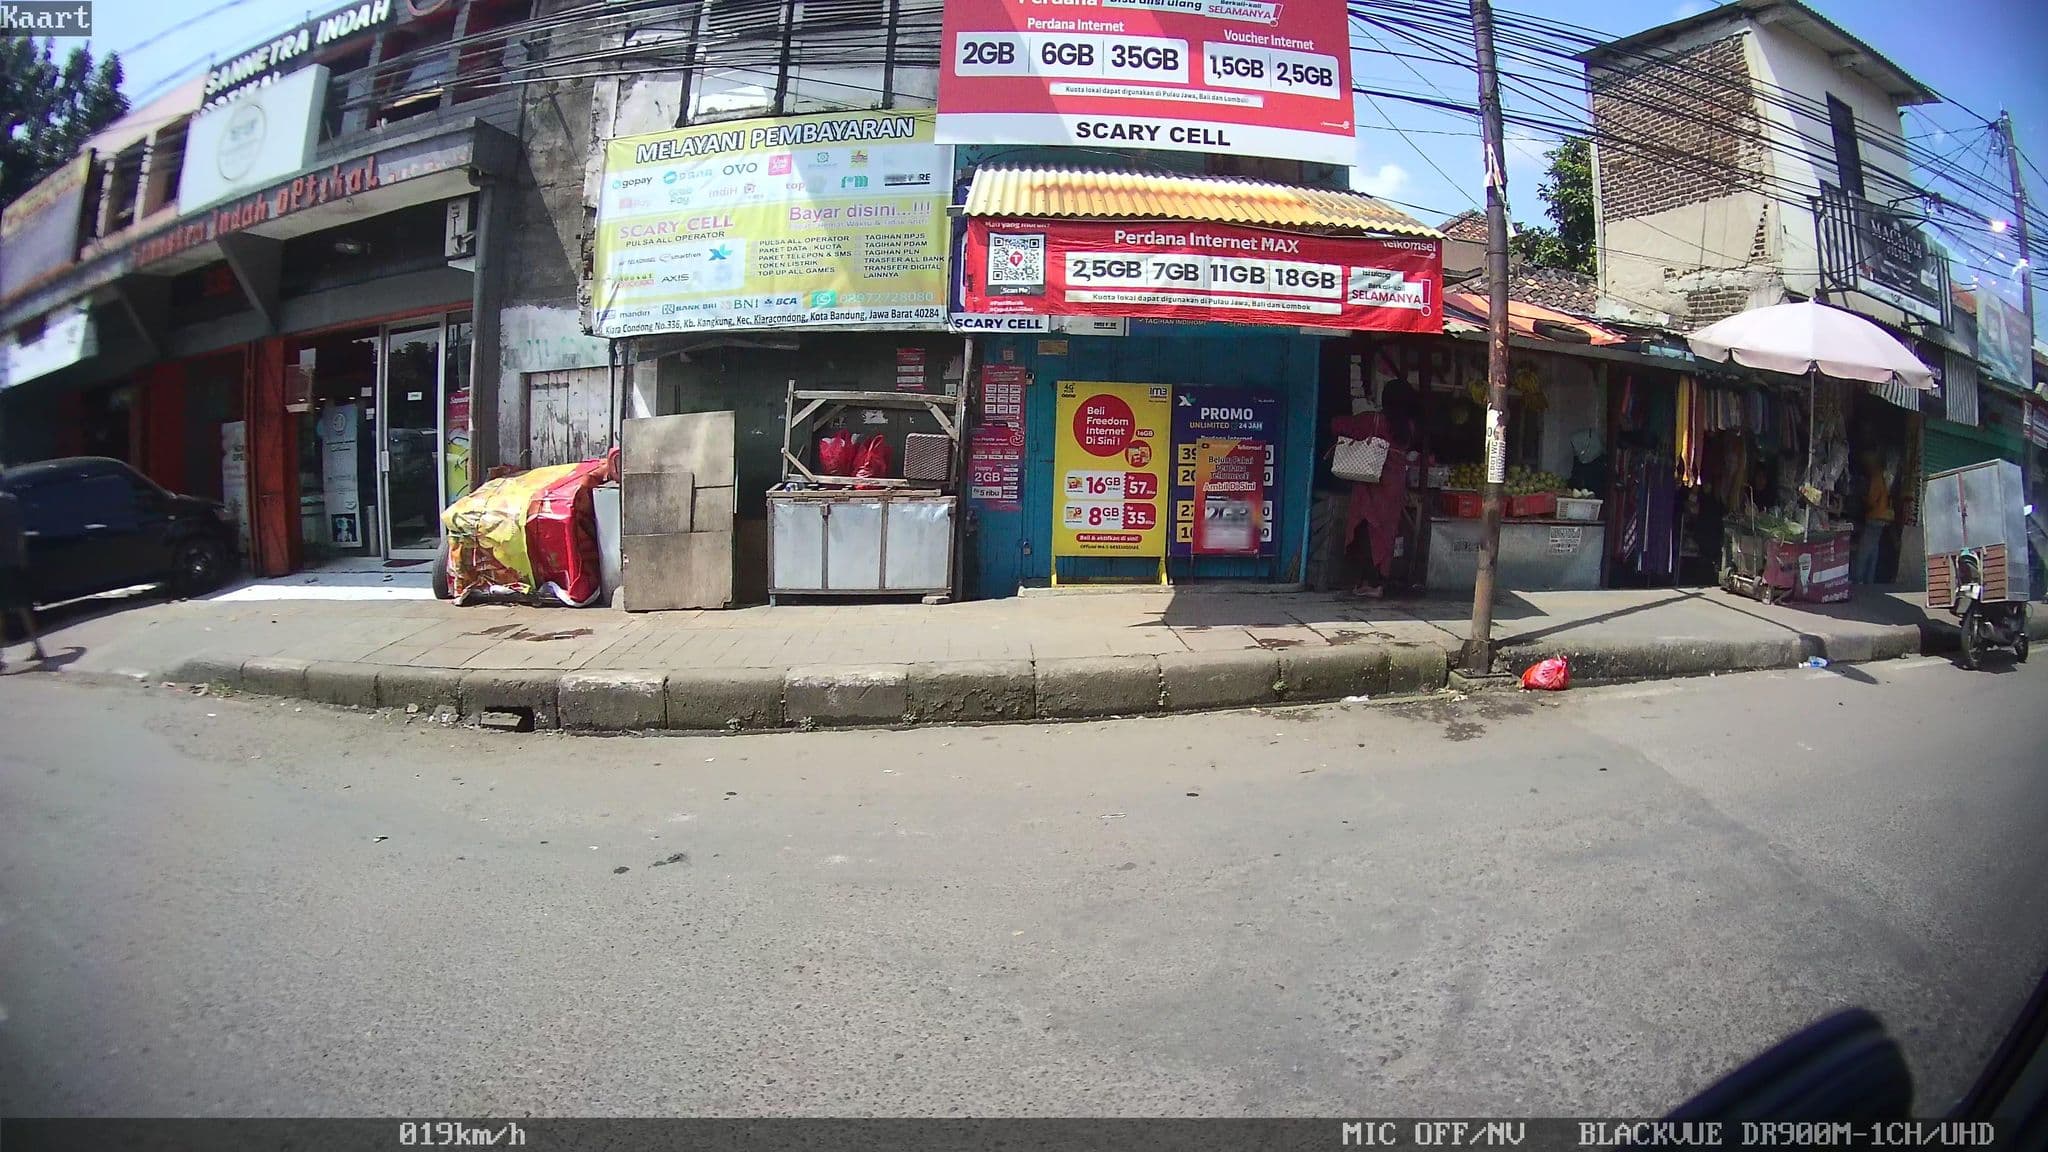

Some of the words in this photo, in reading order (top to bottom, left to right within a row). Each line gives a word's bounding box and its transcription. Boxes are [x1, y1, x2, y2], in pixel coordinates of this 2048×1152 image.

[316, 0, 390, 45] INDAH
[1027, 17, 1075, 31] Perdana
[1077, 18, 1125, 32] Internet
[1224, 29, 1269, 46] Voucher
[1271, 34, 1314, 51] Internet
[962, 42, 1015, 65] 2GB
[1042, 42, 1094, 66] 6GB
[1111, 44, 1179, 70] 35GB
[1209, 54, 1265, 79] 1,5GB
[1277, 62, 1334, 87] 2,5GB
[1102, 87, 1121, 97] dapat
[1122, 88, 1154, 97] digunakan
[1163, 90, 1180, 98] Pulau
[636, 131, 745, 164] MELAYANI
[751, 116, 915, 149] PEMBAYARAN
[1076, 121, 1160, 141] SCARY
[1170, 126, 1231, 146] CELL
[622, 176, 652, 189] gopay
[722, 162, 758, 176] OVO
[790, 205, 841, 222] Bayar
[620, 221, 679, 239] SCARY
[687, 214, 733, 230] CELL
[626, 238, 654, 247] PULSA
[656, 236, 673, 244] ALL
[675, 231, 725, 242] OPERATOR
[804, 235, 850, 243] OPERATOR
[1114, 230, 1186, 246] Perdana
[1190, 231, 1257, 250] Internet
[1261, 237, 1299, 253] MAX
[662, 273, 689, 283] AXIS
[1072, 260, 1141, 281] 2,5GB
[1153, 262, 1199, 281] 7GB
[1210, 264, 1265, 284] 11GB
[1275, 268, 1335, 289] 18GB
[676, 304, 700, 312] BANK
[734, 299, 758, 310] BNI
[776, 297, 797, 305] BCA
[1137, 295, 1159, 304] dapat
[1161, 296, 1199, 306] digunakan
[1282, 303, 1311, 311] Lombok
[697, 318, 736, 328] Kangkung,
[737, 316, 753, 325] Kec.
[754, 313, 809, 325] Kiaracondong,
[810, 312, 828, 321] Kota
[830, 310, 867, 322] Bandung,
[869, 309, 889, 319] Jawa
[891, 308, 912, 319] Barat
[914, 308, 939, 318] 40284
[954, 318, 1003, 330] SCARY
[1008, 319, 1042, 329] CELL
[1087, 406, 1105, 415] Beli
[1200, 407, 1254, 421] PROMO
[1086, 417, 1129, 426] Freedom
[1189, 421, 1230, 430] UNLIMITED
[1086, 427, 1125, 436] Internet
[1086, 437, 1096, 445] Di
[1097, 437, 1115, 446] Sini
[1086, 476, 1106, 494] 16
[1105, 477, 1121, 486] GB
[1129, 481, 1147, 494] 57
[1089, 507, 1102, 526] 8
[1103, 507, 1119, 517] GB
[1127, 511, 1146, 525] 35
